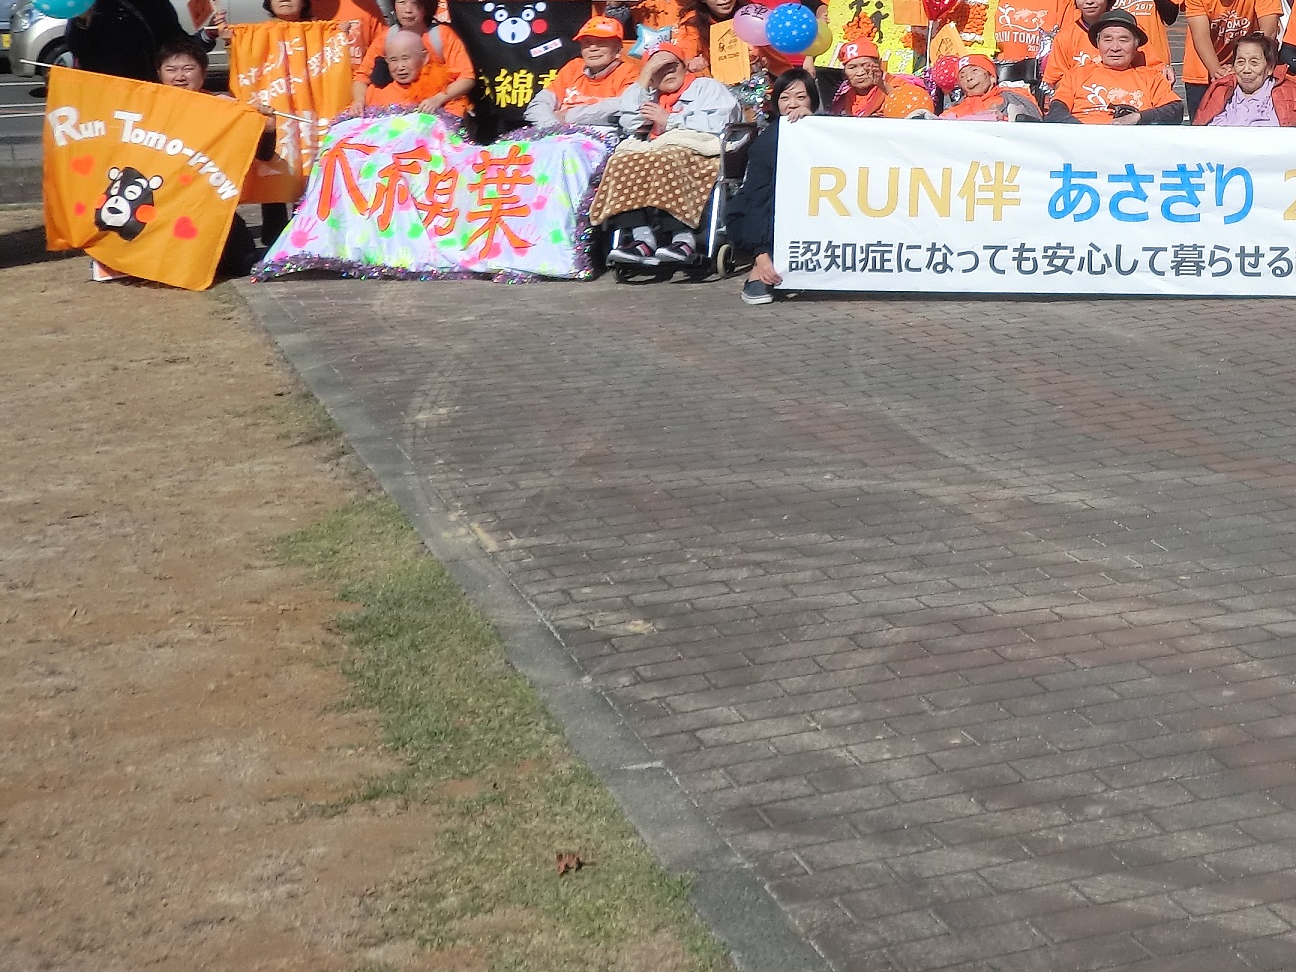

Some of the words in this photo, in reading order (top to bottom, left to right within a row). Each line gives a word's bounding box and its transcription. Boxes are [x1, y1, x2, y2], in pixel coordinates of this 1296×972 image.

[1135, 3, 1154, 11] 2017
[47, 105, 107, 147] Run
[112, 110, 240, 201] Tomo-rrow
[807, 160, 1021, 223] RUN伴
[1047, 162, 1254, 225] あさぎり
